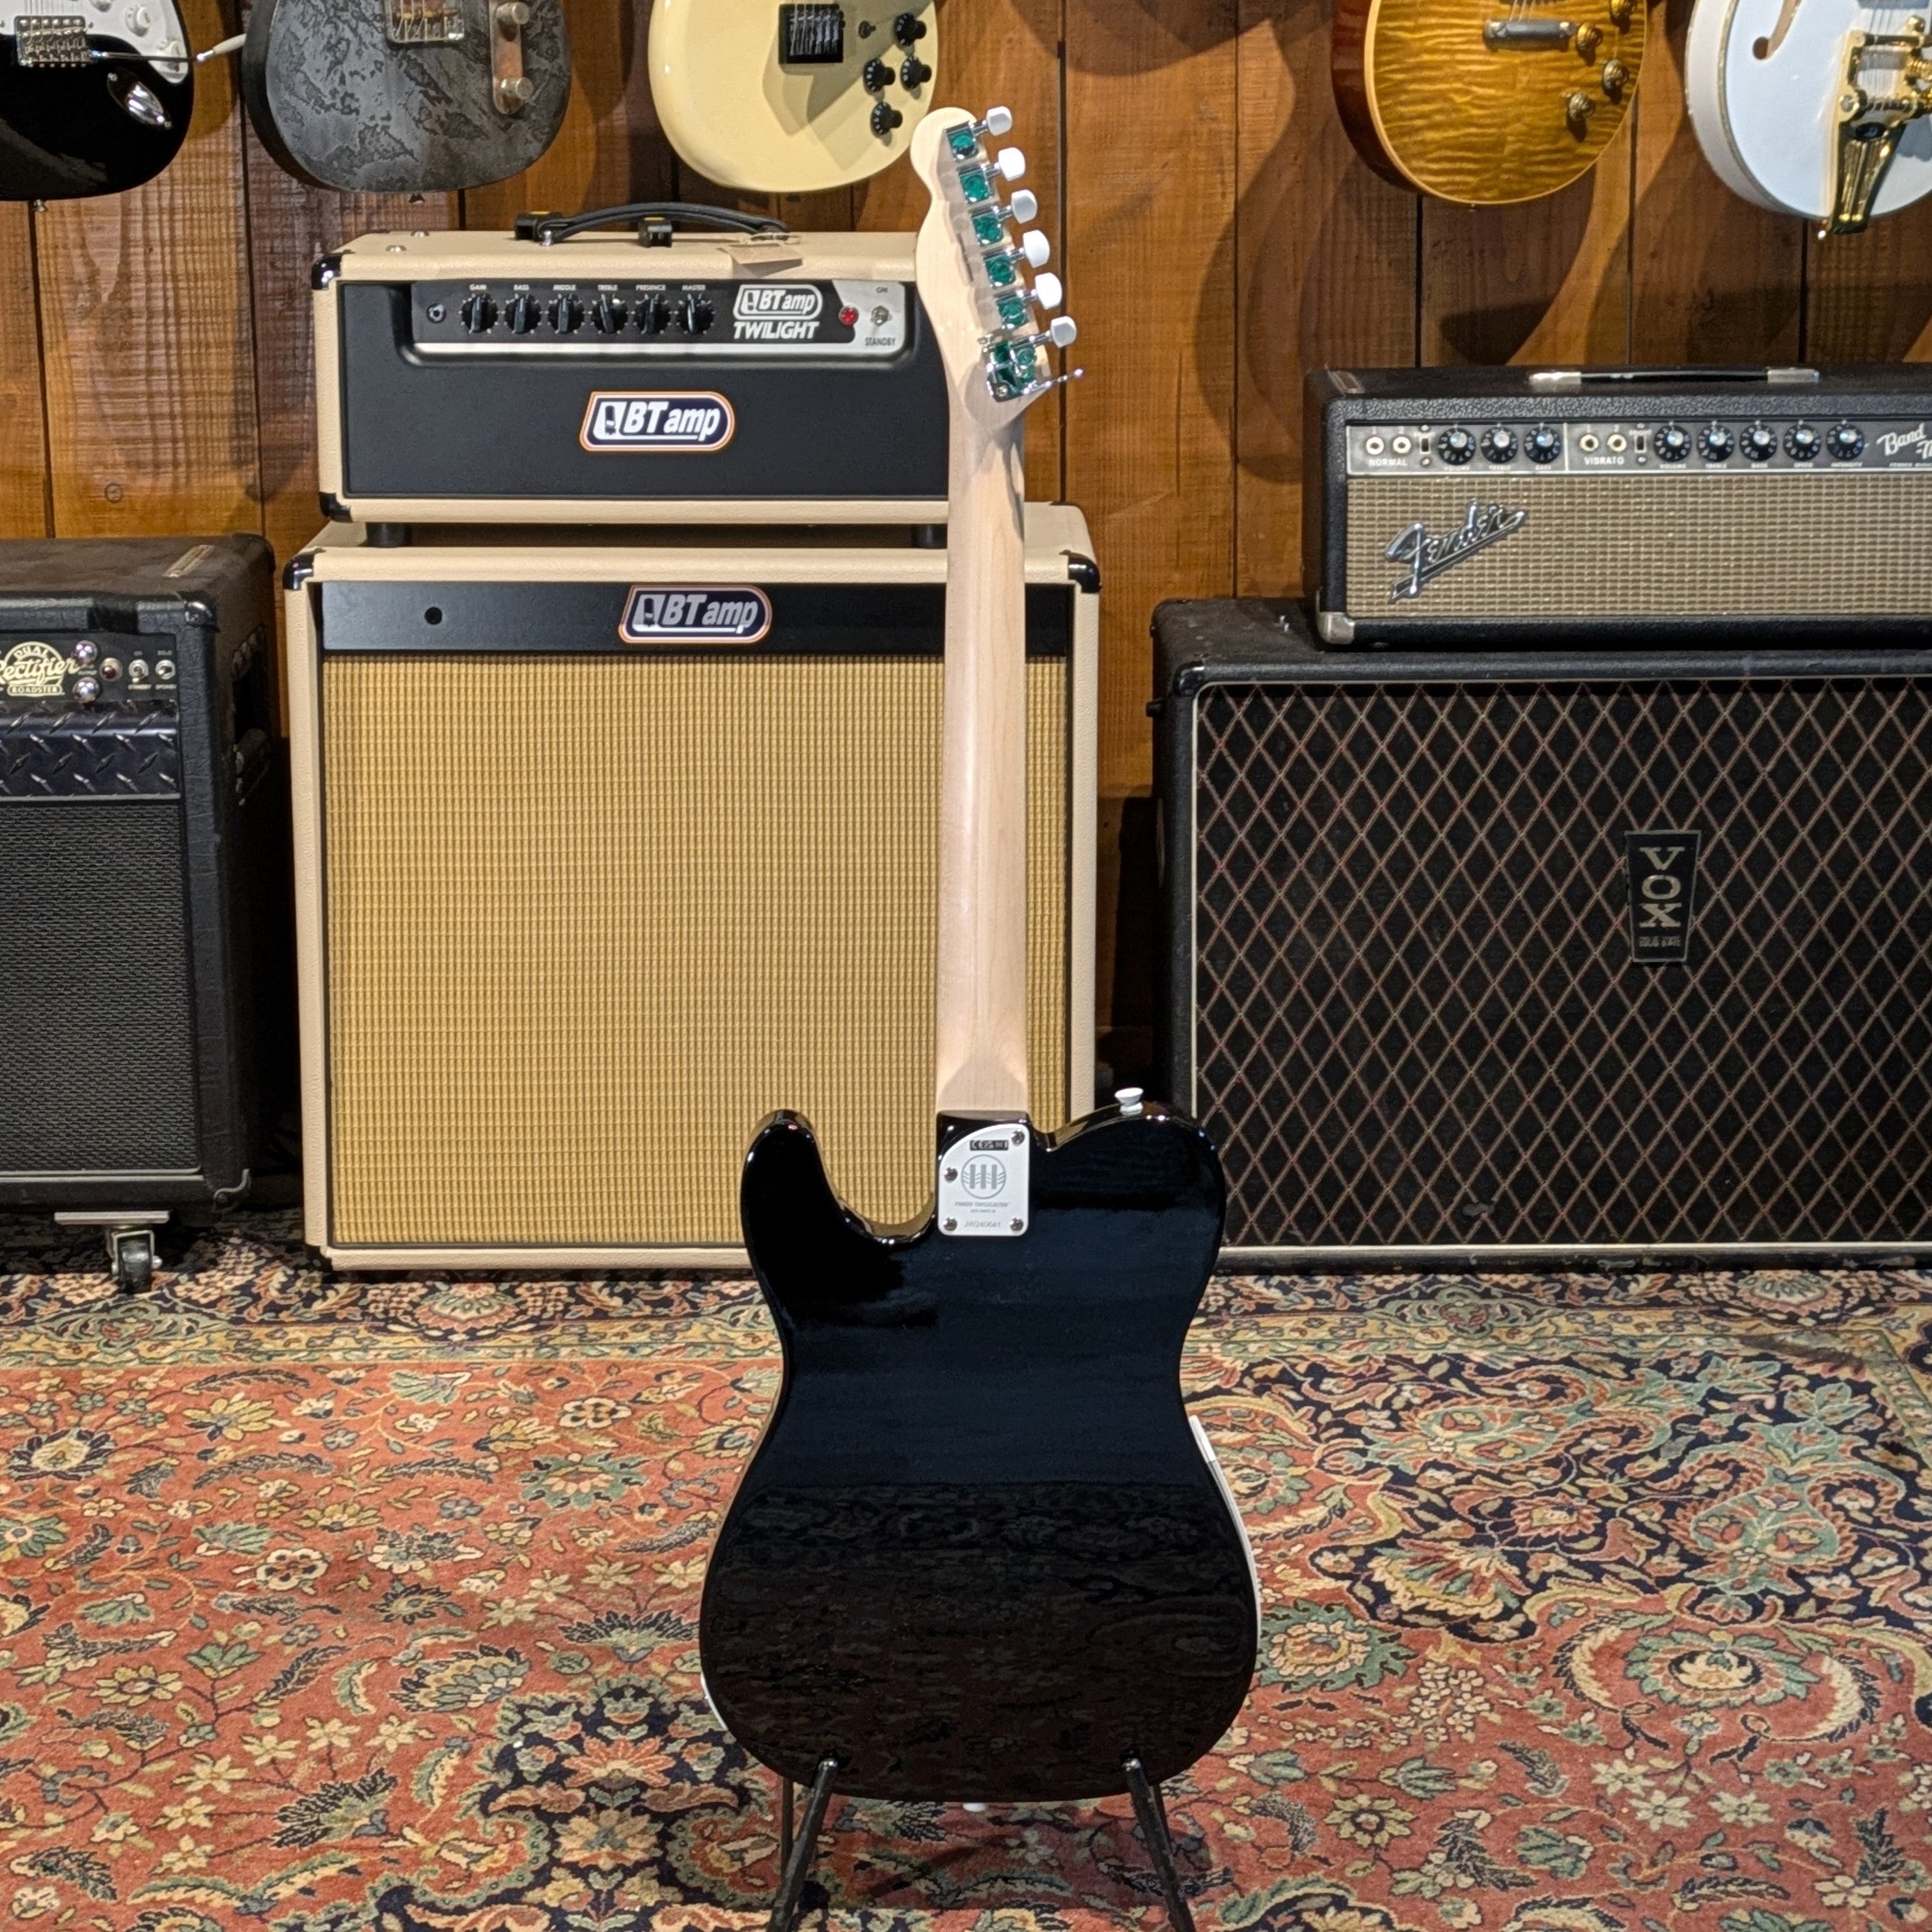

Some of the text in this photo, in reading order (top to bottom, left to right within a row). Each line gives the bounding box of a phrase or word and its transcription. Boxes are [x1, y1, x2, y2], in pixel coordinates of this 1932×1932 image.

[733, 322, 820, 339] TWILIGHT
[865, 337, 896, 346] STANDBY
[1875, 422, 1927, 456] Band
[1584, 456, 1625, 465] VIBRATO
[1385, 498, 1527, 600] Fender
[14, 645, 49, 659] DUAL
[1639, 847, 1685, 928] VOX
